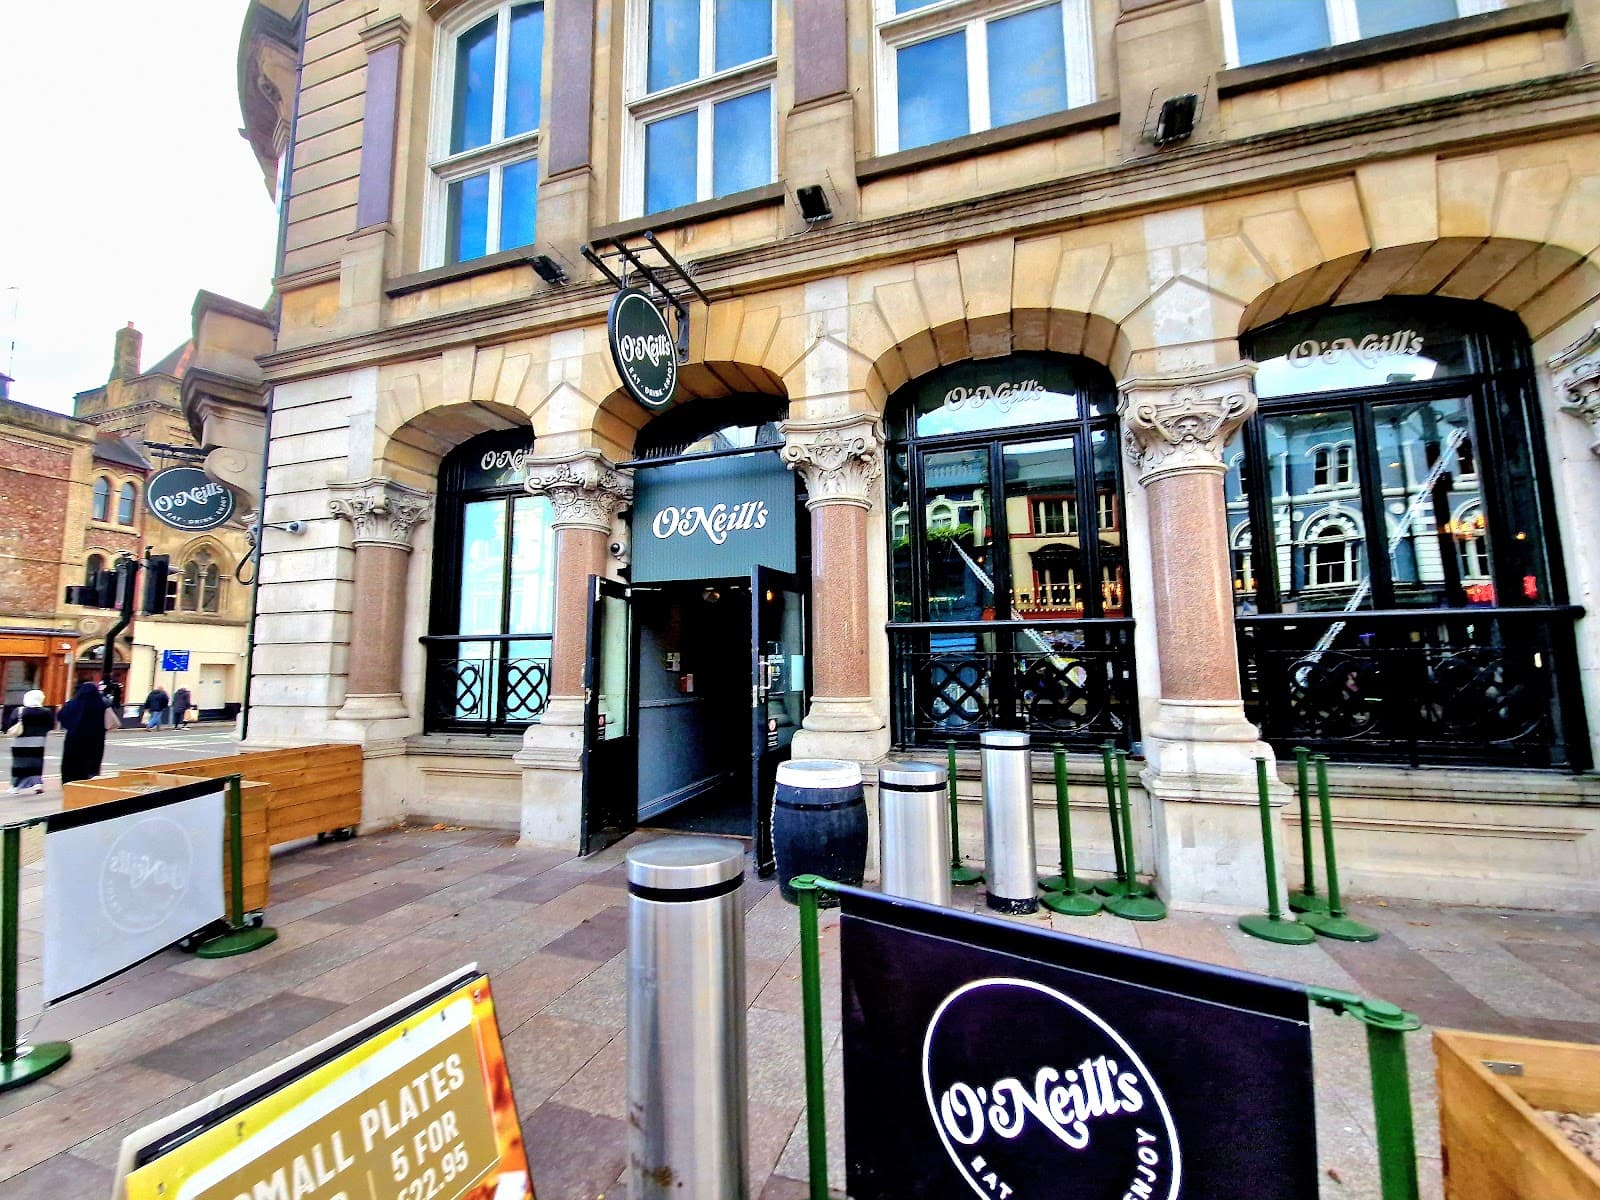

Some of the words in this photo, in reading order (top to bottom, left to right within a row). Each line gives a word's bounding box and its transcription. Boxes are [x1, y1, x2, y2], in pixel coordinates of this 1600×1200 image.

[621, 334, 672, 367] O'Neill's
[1288, 329, 1425, 369] O'Neill's
[628, 366, 641, 385] EAT
[943, 379, 1046, 413] O'Neill's
[154, 482, 224, 512] O'Neill's
[652, 500, 769, 545] O'Neill's
[941, 1055, 1143, 1150] O'Neill's
[231, 1130, 355, 1200] MALL
[359, 1053, 465, 1153] PLATES
[391, 1145, 409, 1182] 5
[413, 1110, 459, 1166] FOR
